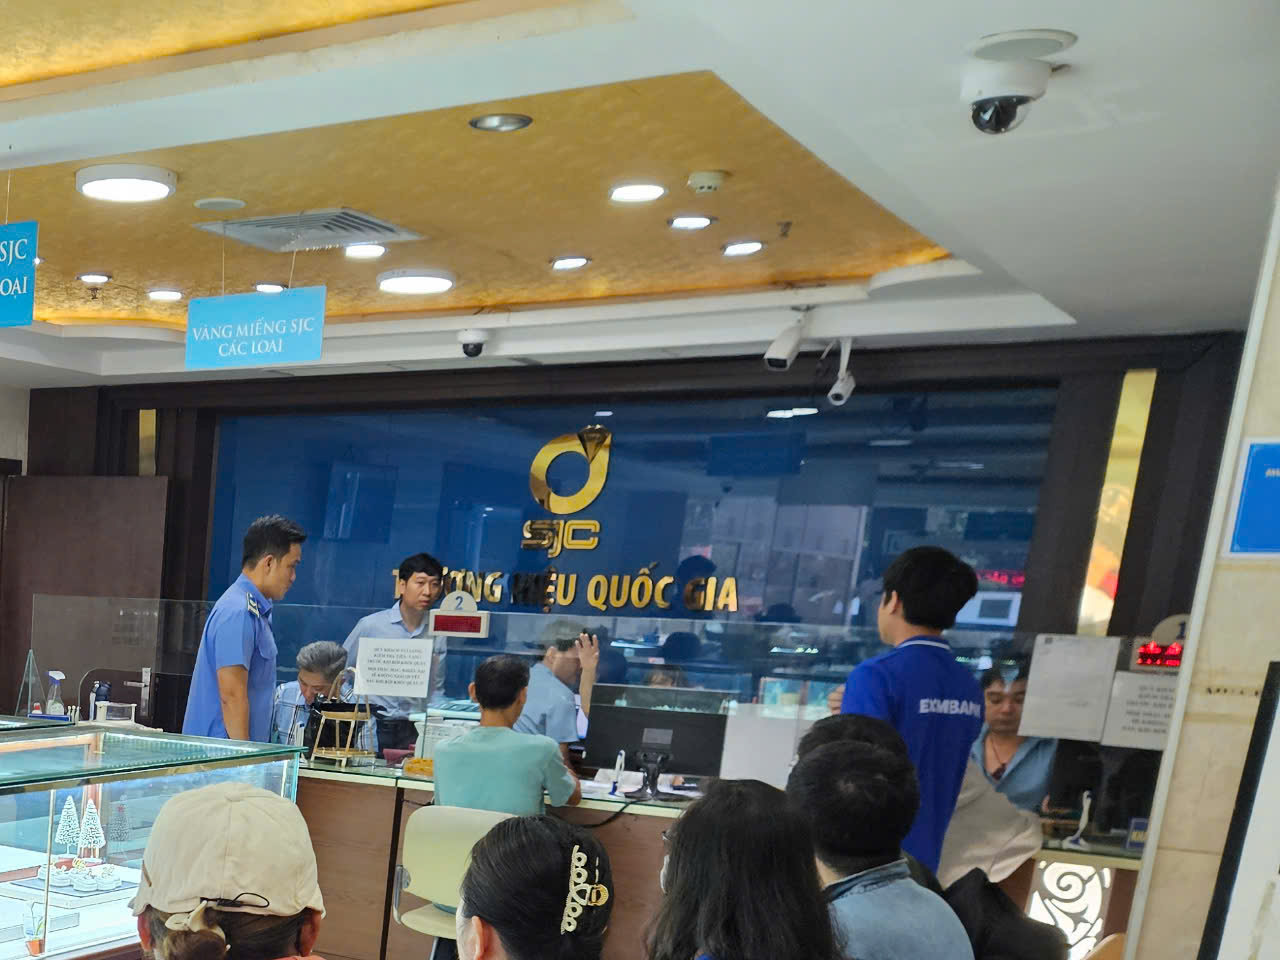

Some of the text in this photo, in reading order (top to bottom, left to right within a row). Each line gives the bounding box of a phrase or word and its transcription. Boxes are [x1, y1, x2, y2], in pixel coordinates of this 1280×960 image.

[192, 324, 233, 341] VÀNG
[290, 317, 316, 335] SJC
[218, 339, 249, 357] CÁC
[522, 519, 601, 558] SJC
[586, 561, 675, 612] QUỐC
[683, 575, 739, 612] GIA
[454, 595, 464, 611] 2
